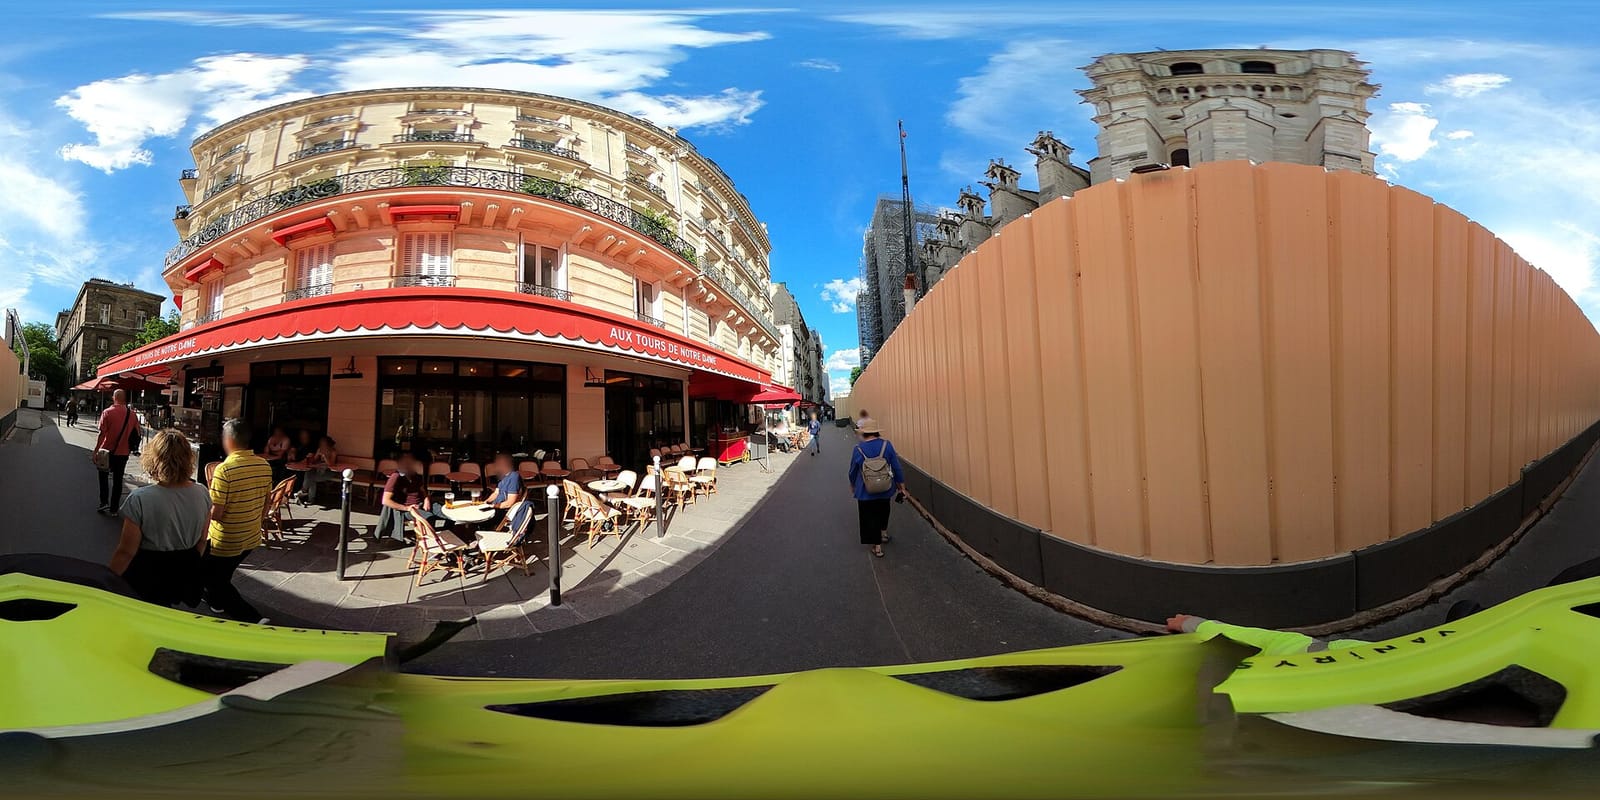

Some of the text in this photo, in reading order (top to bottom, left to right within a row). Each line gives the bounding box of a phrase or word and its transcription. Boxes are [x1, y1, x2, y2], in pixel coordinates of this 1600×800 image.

[178, 338, 196, 350] DAME
[610, 327, 717, 365] AUX TOURS DE NOTRE DAME
